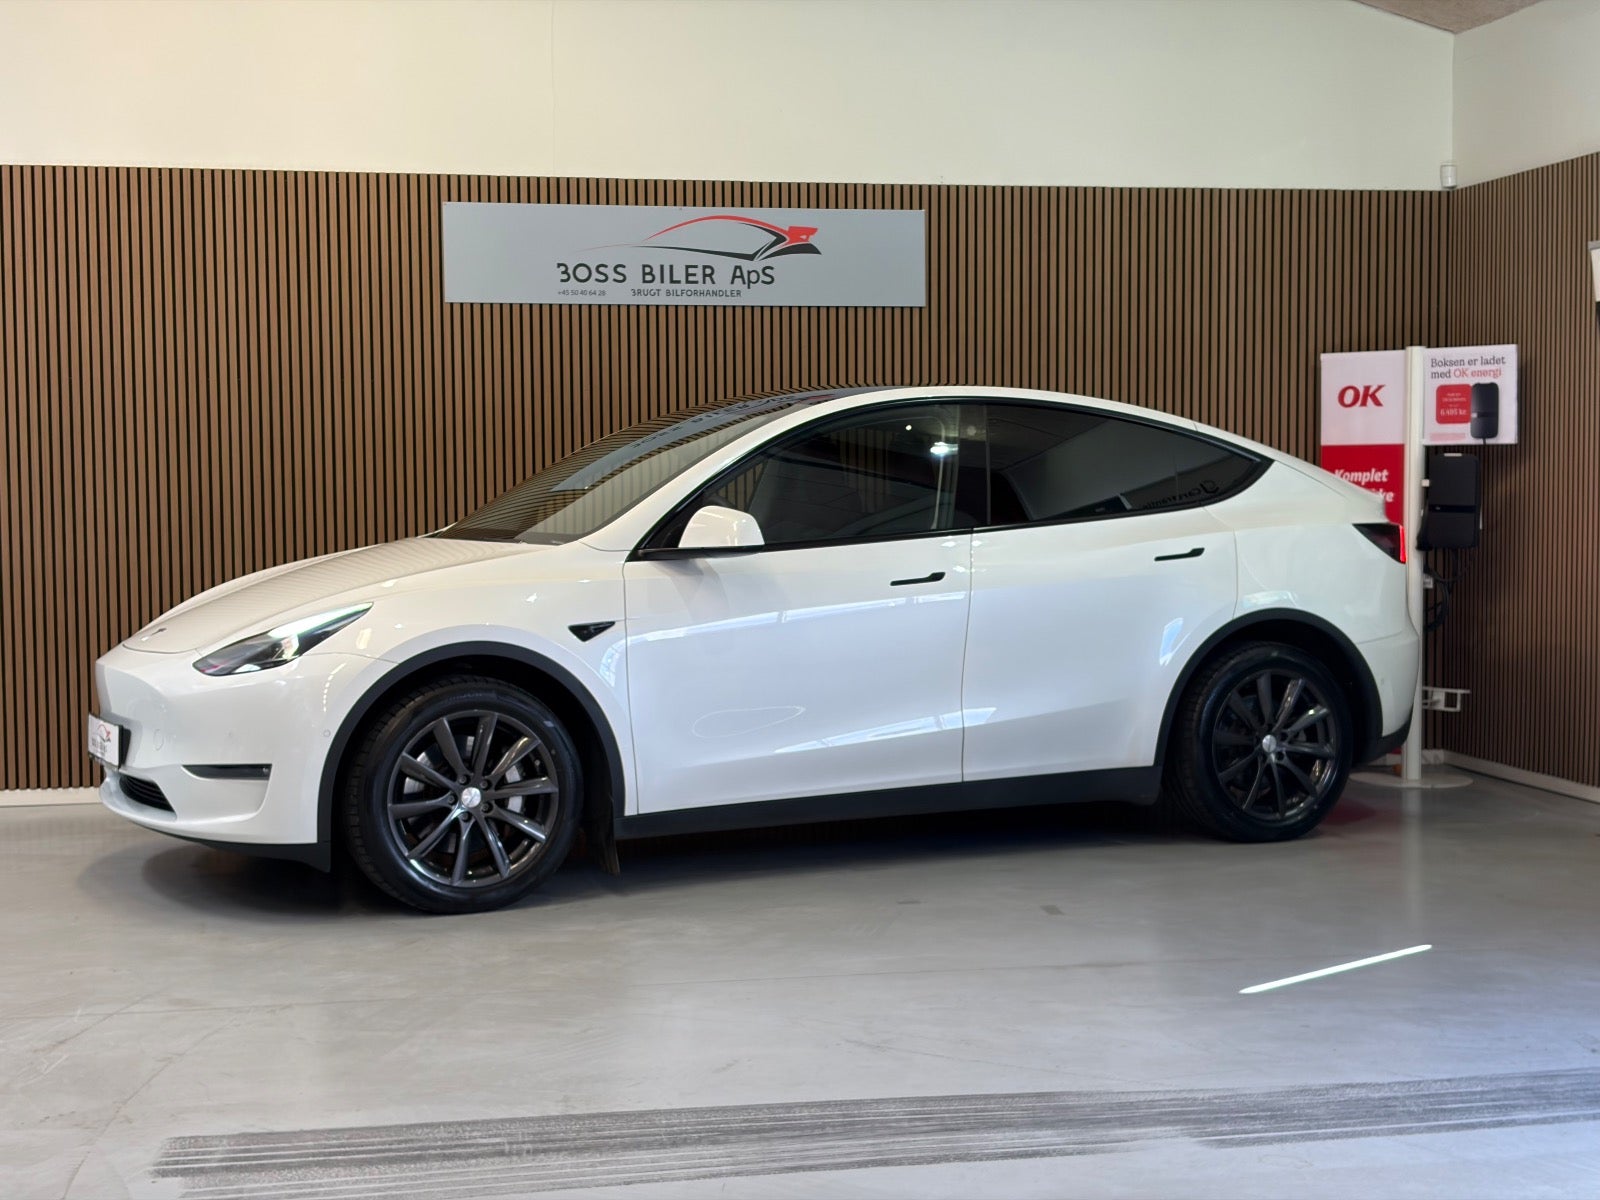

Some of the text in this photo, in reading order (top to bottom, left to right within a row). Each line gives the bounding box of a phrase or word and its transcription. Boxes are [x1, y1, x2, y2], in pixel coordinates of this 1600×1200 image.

[641, 263, 716, 285] BILER
[730, 265, 776, 290] ApS
[665, 288, 743, 298] BILFORHANDLER
[1430, 355, 1506, 369] Boksen er ladet
[1430, 367, 1502, 380] med OK energi
[1337, 384, 1386, 409] OK
[1334, 467, 1390, 487] Komplet
